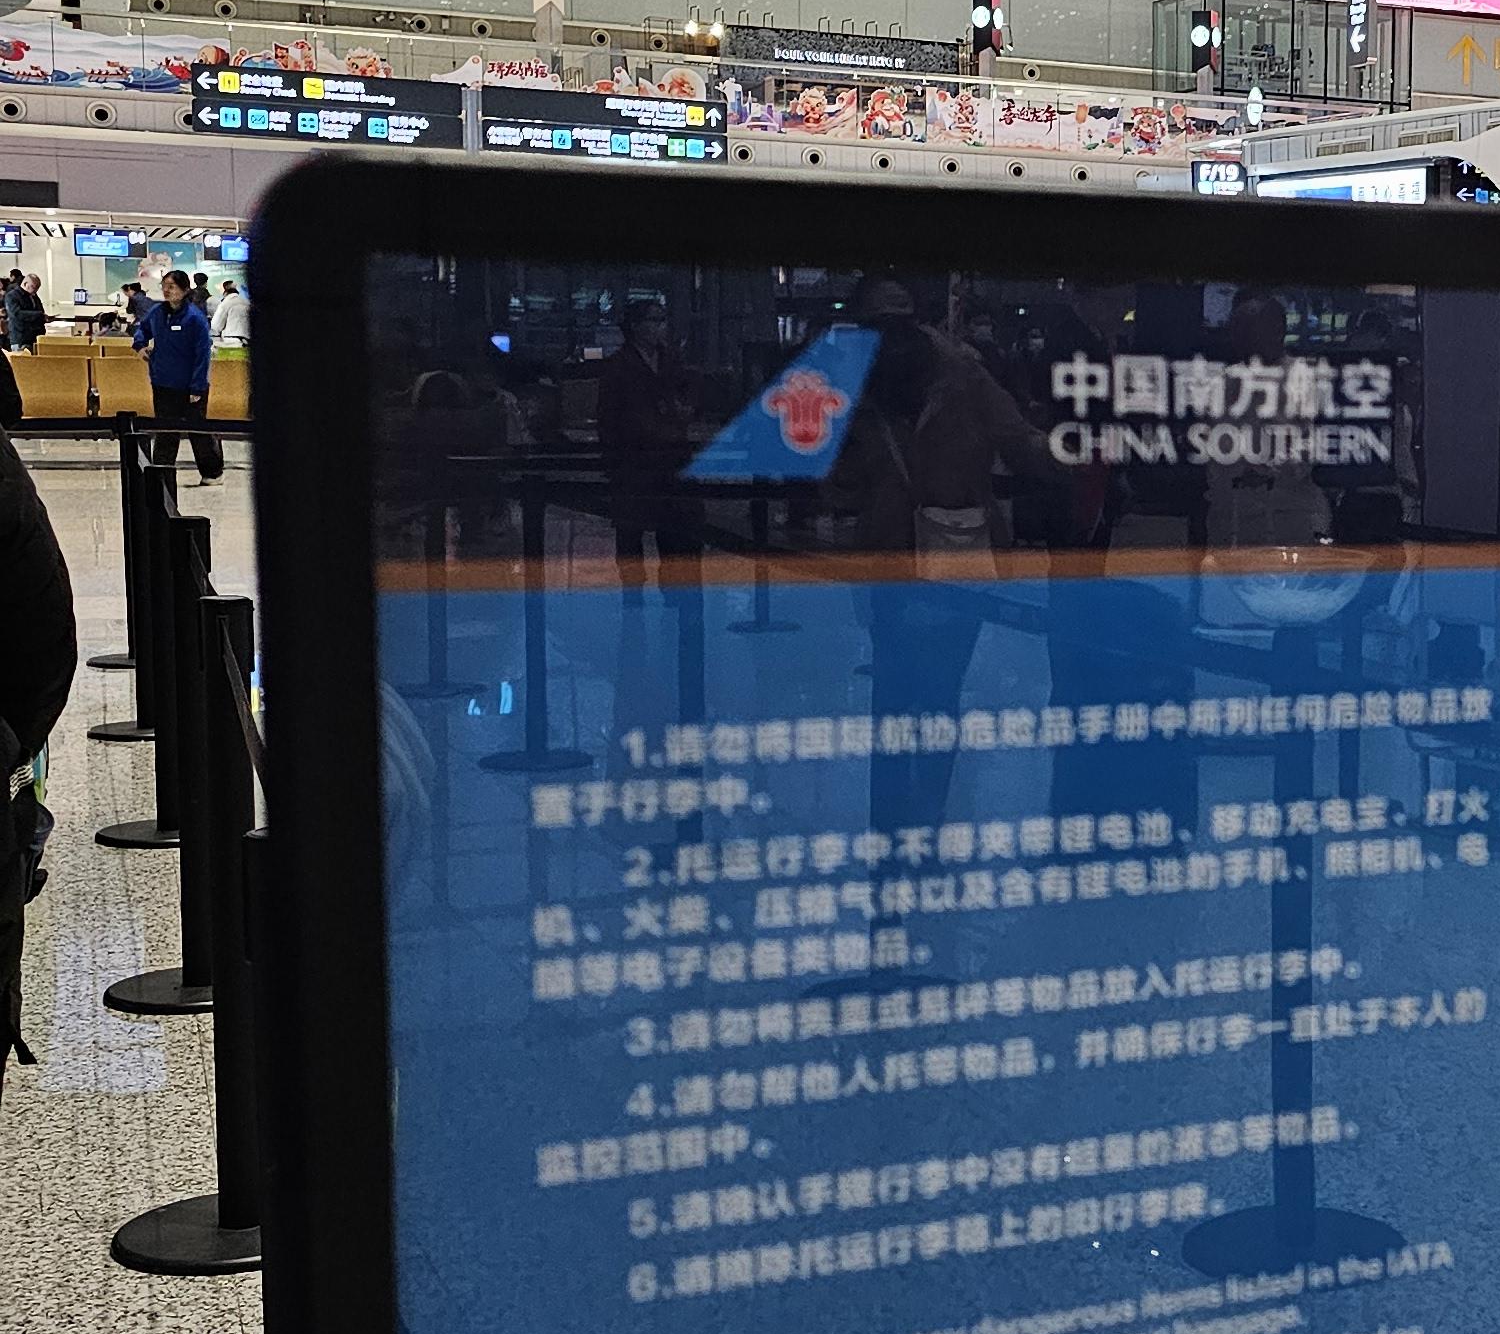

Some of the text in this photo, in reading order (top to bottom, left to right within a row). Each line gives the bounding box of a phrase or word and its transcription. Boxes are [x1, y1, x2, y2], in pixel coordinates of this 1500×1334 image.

[775, 48, 805, 61] POUR
[805, 51, 834, 63] YOUR
[1000, 99, 1058, 134] 喜迎龙年
[1200, 164, 1239, 181] F/19
[1052, 351, 1391, 419] 中国南方航空
[1049, 423, 1391, 465] CHINA SOUTHERN
